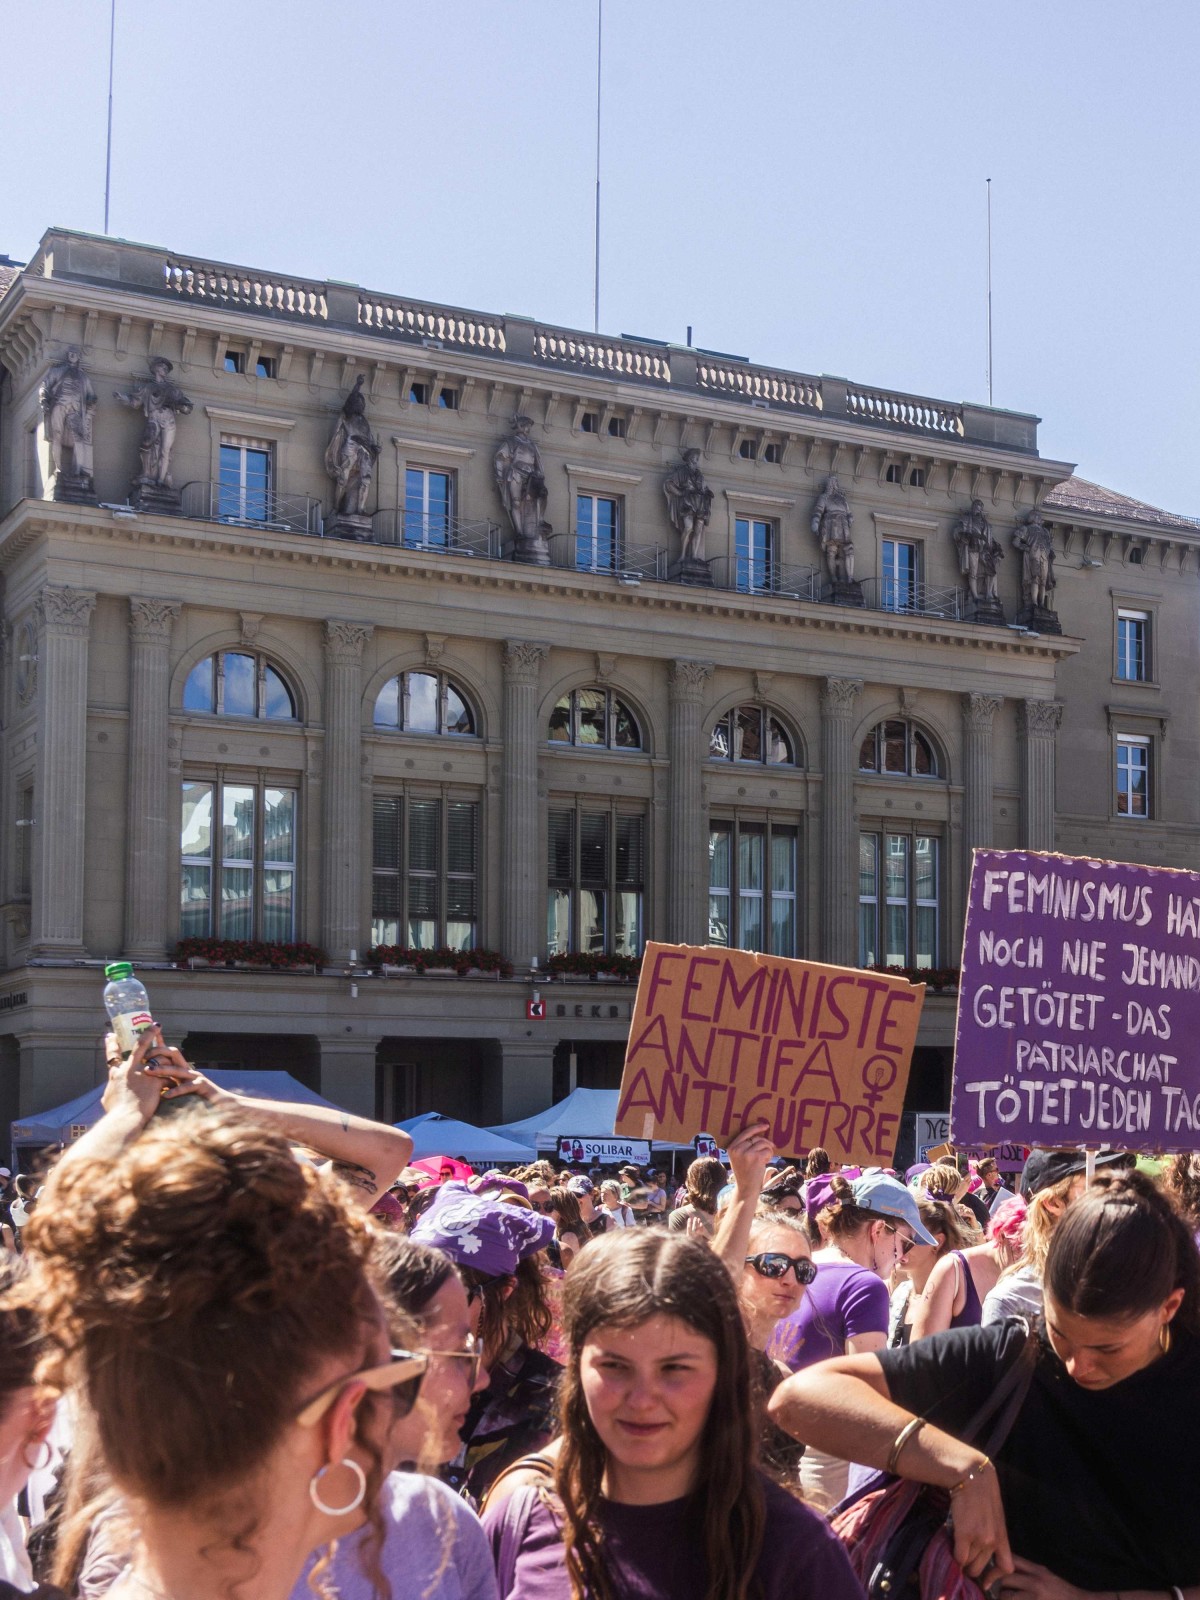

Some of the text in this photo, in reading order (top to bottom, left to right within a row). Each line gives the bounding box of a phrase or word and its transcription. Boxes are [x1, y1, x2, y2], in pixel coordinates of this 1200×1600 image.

[982, 870, 1153, 927] FEMINISMUS
[979, 930, 1043, 968] NOCH
[1061, 938, 1107, 981] NIE
[556, 1004, 619, 1018] BEKB
[646, 952, 916, 1055] FEMINISTE
[973, 980, 1105, 1031] GETÖTET
[627, 1014, 841, 1101] ANTIFA
[1016, 1039, 1179, 1083] PATRIARCHAT
[585, 1143, 633, 1156] SOLIBAR
